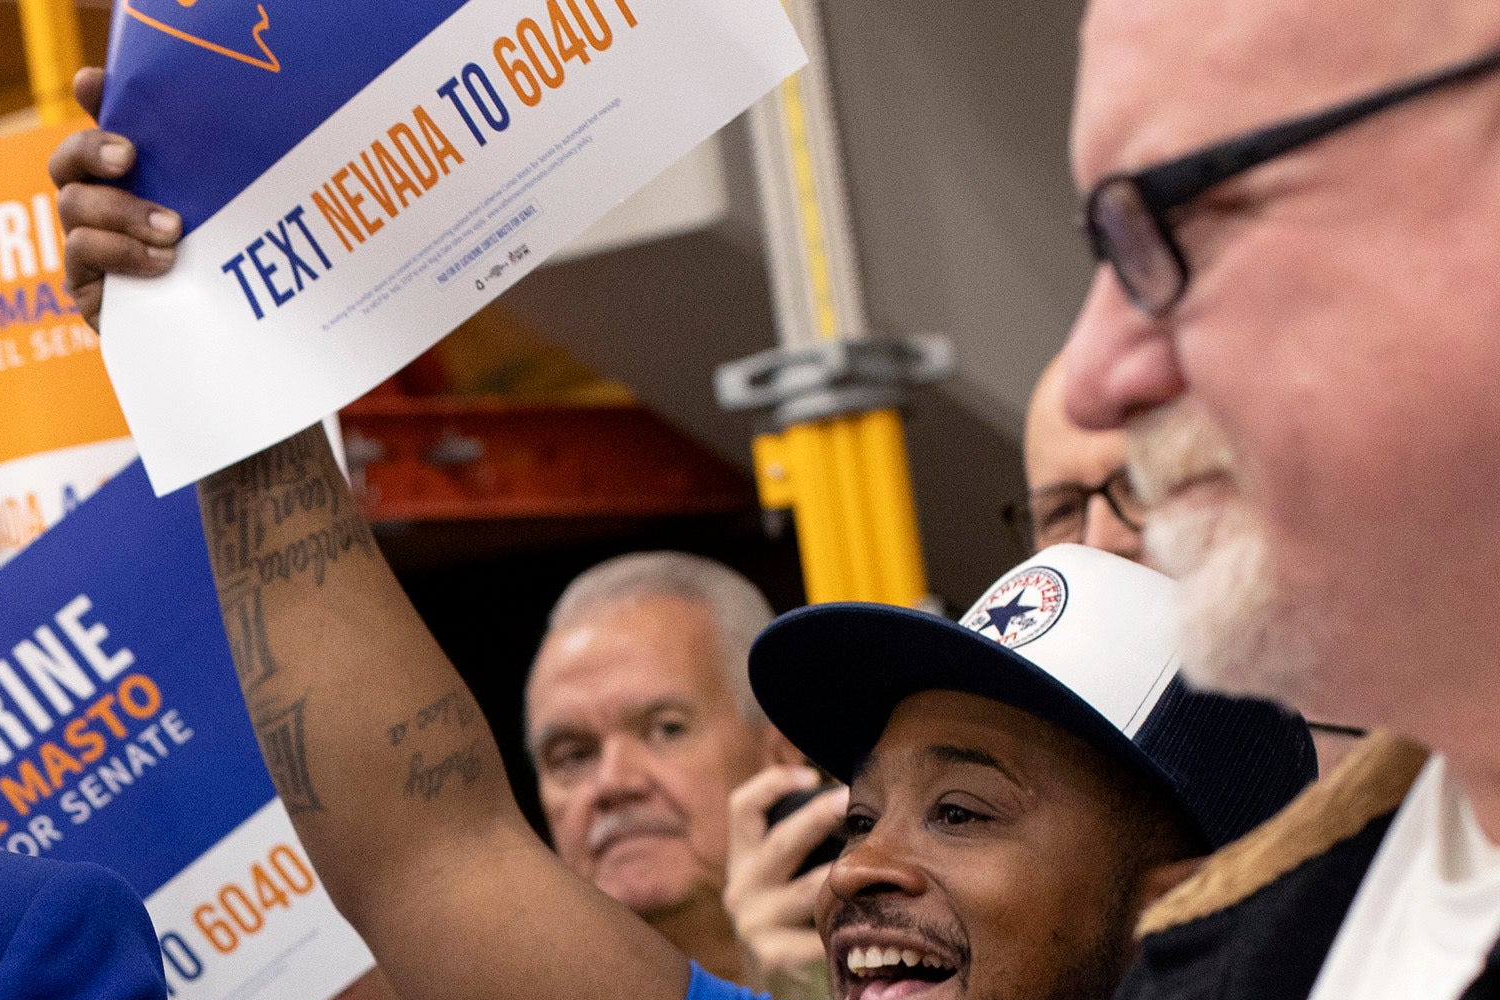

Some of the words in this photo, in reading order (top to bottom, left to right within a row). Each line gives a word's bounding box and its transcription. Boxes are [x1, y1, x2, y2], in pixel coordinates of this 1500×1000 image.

[221, 204, 333, 320] TEXT
[310, 105, 466, 253] NEVADA
[436, 62, 510, 147] TO
[60, 709, 195, 824] SENATE
